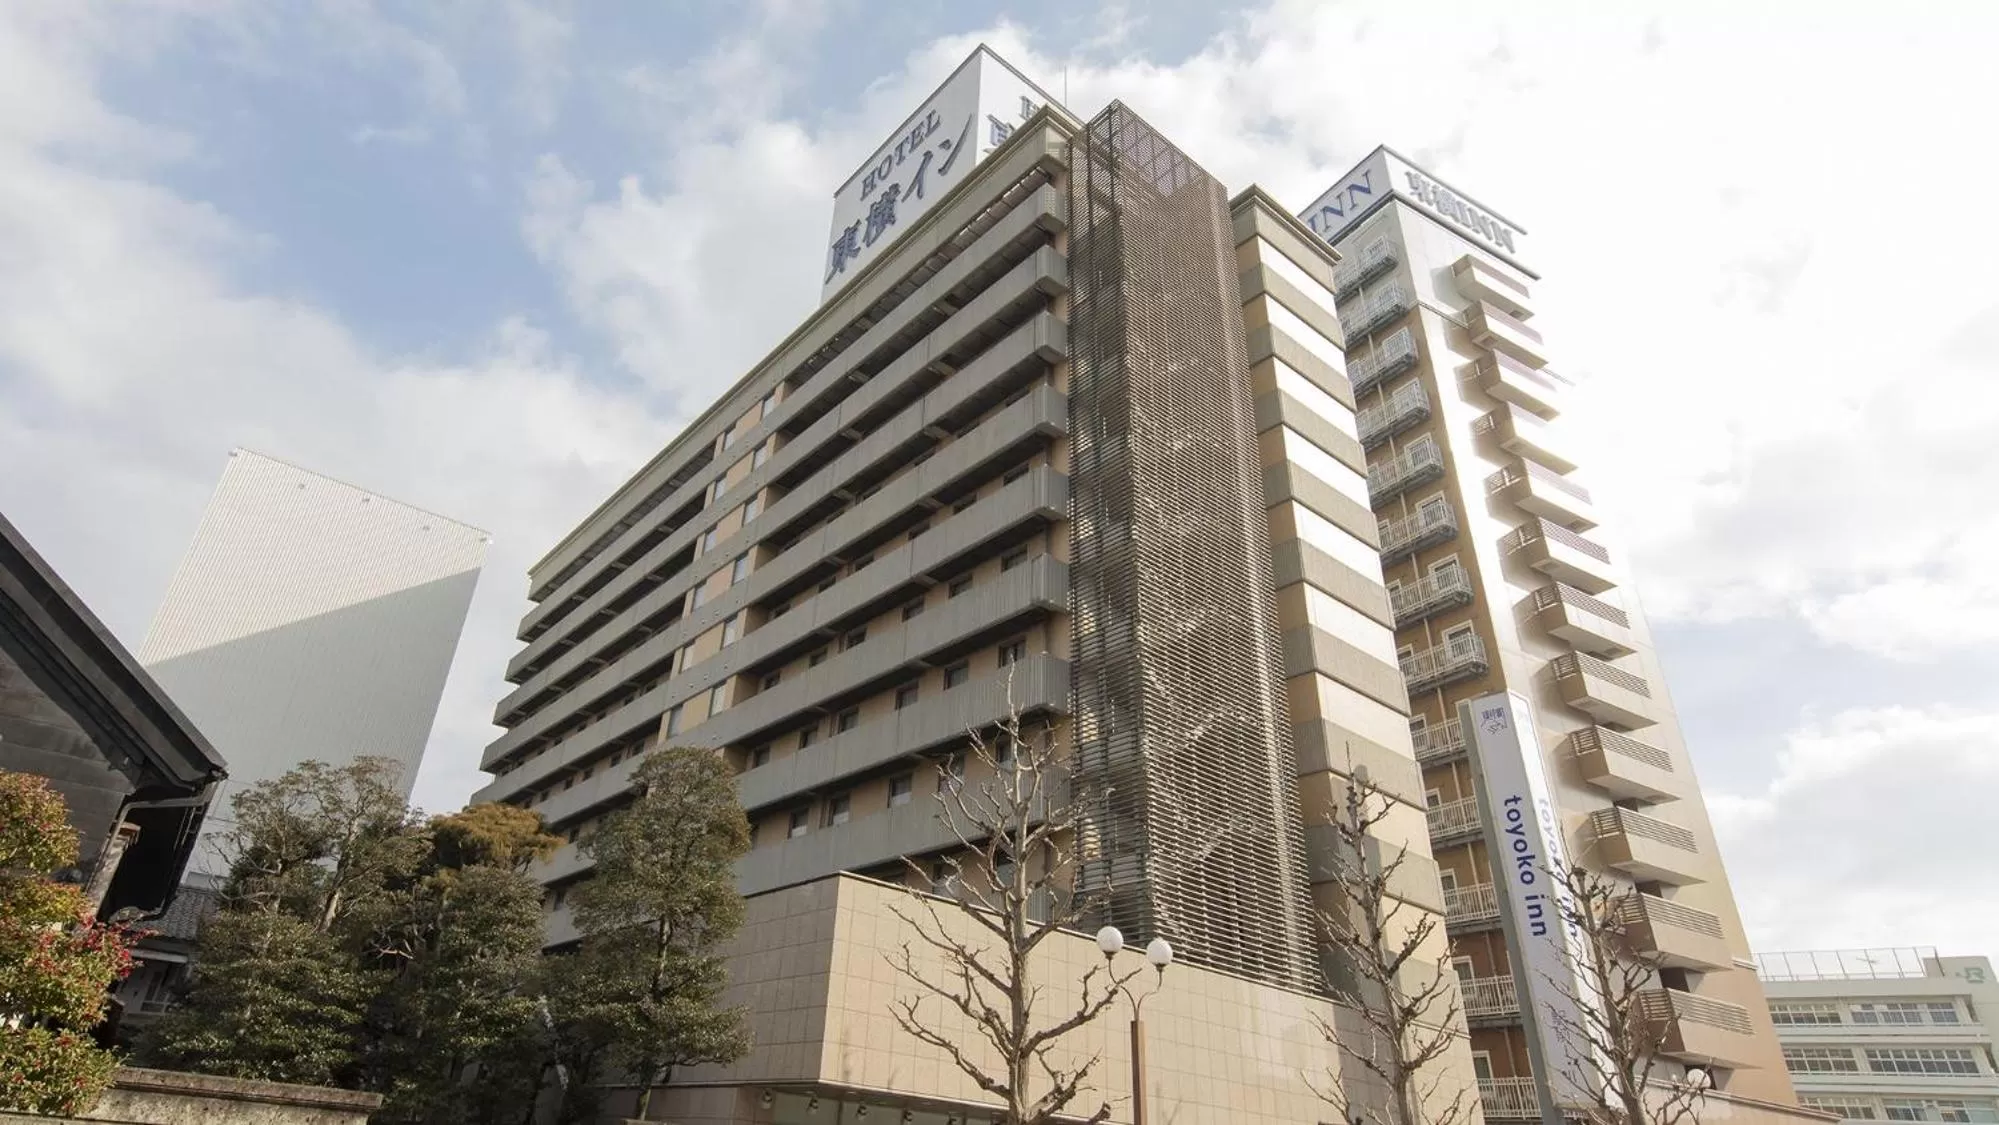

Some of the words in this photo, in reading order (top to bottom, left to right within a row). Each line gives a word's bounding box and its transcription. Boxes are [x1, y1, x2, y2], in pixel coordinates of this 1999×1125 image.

[825, 113, 972, 284] 東横イン
[860, 110, 941, 201] HOTEL
[1307, 169, 1372, 233] INN
[1504, 795, 1536, 885] toyoko
[1525, 895, 1547, 936] inn
